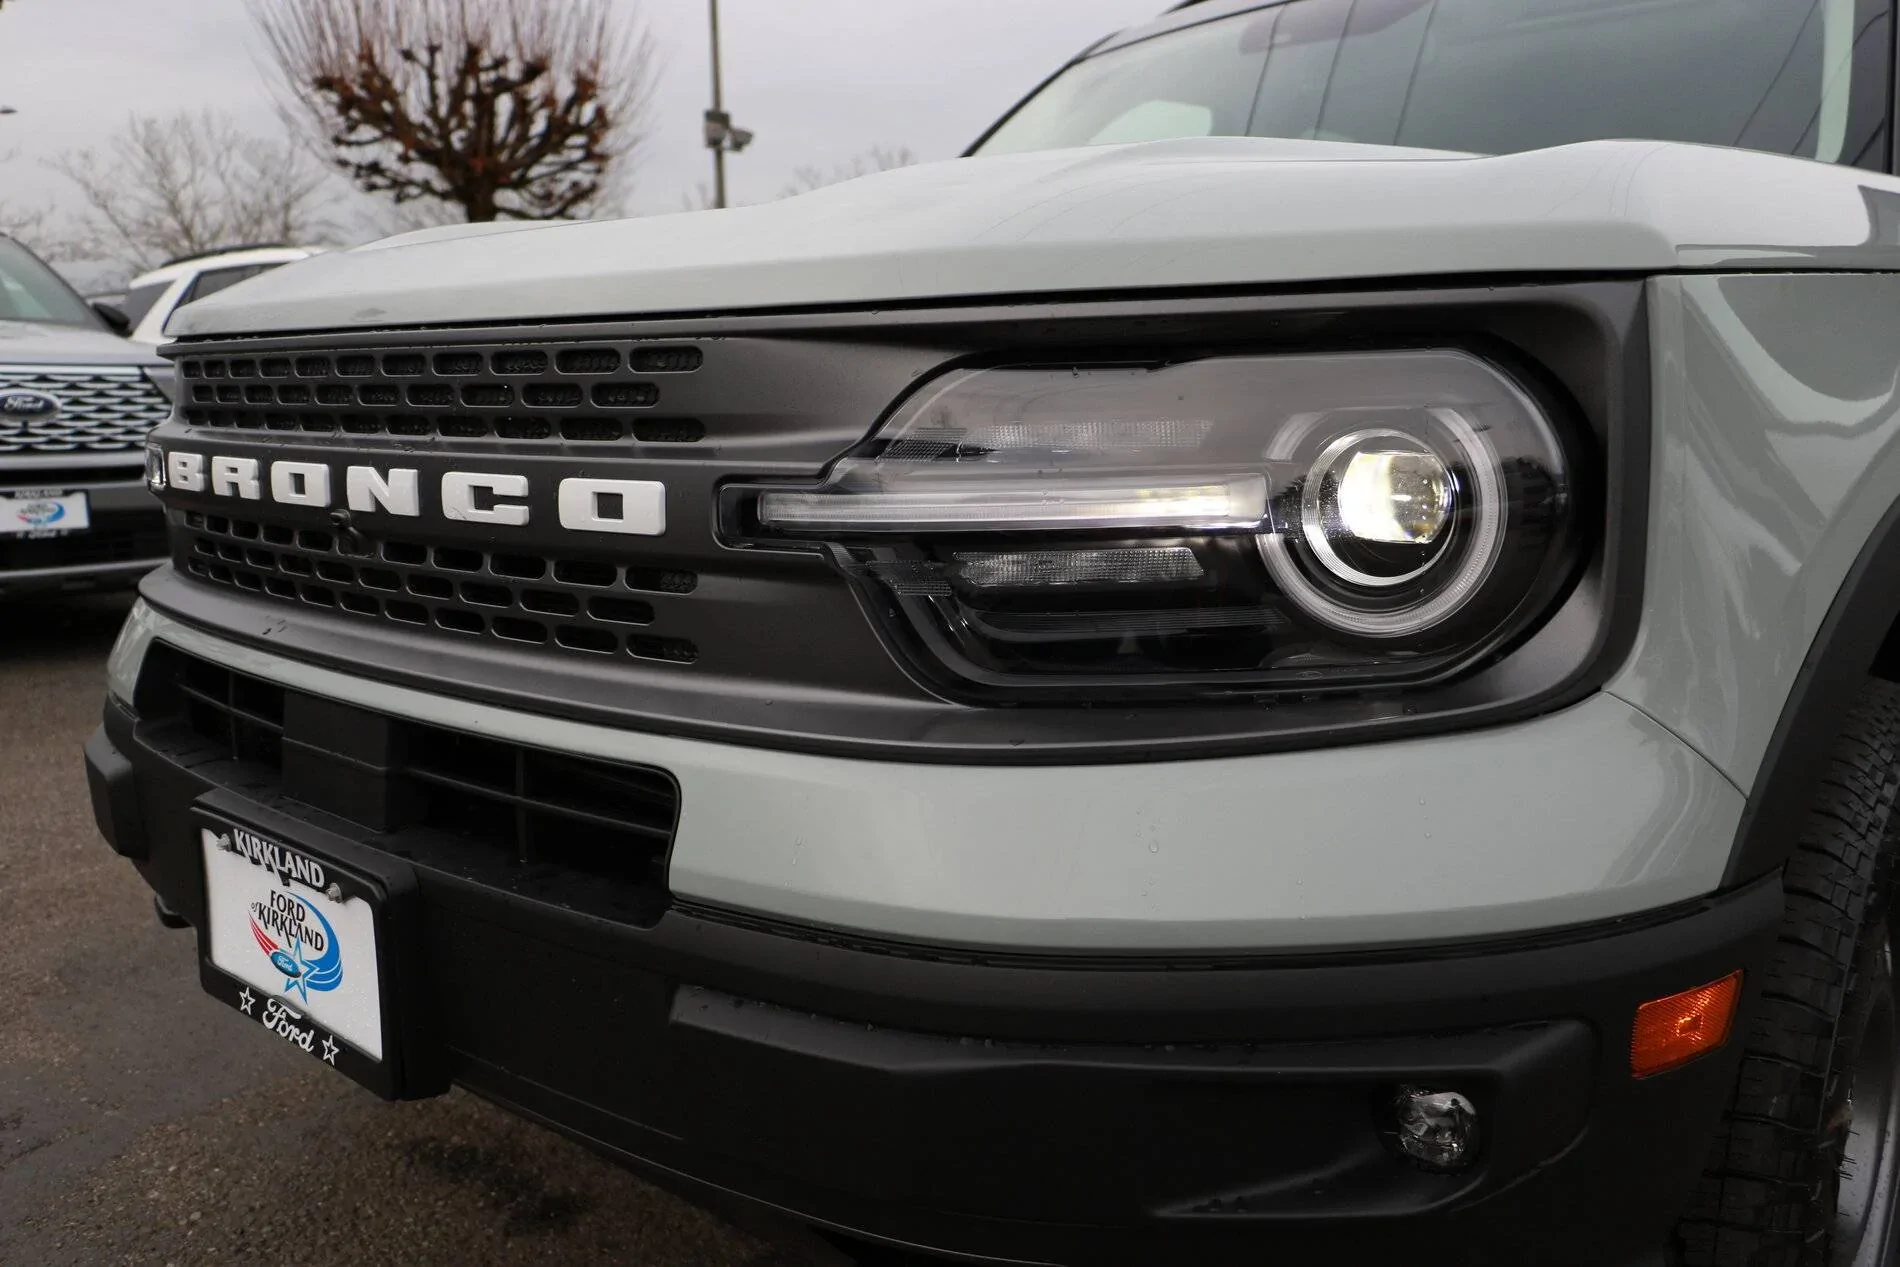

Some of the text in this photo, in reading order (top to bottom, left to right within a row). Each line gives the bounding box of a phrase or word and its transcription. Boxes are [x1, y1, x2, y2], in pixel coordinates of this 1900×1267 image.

[167, 451, 666, 536] BRONCO
[233, 829, 325, 888] KIRKLAND
[258, 902, 324, 951] KIRKLAND
[270, 889, 306, 924] FORD
[276, 955, 294, 972] Ford
[262, 998, 315, 1053] Ford
